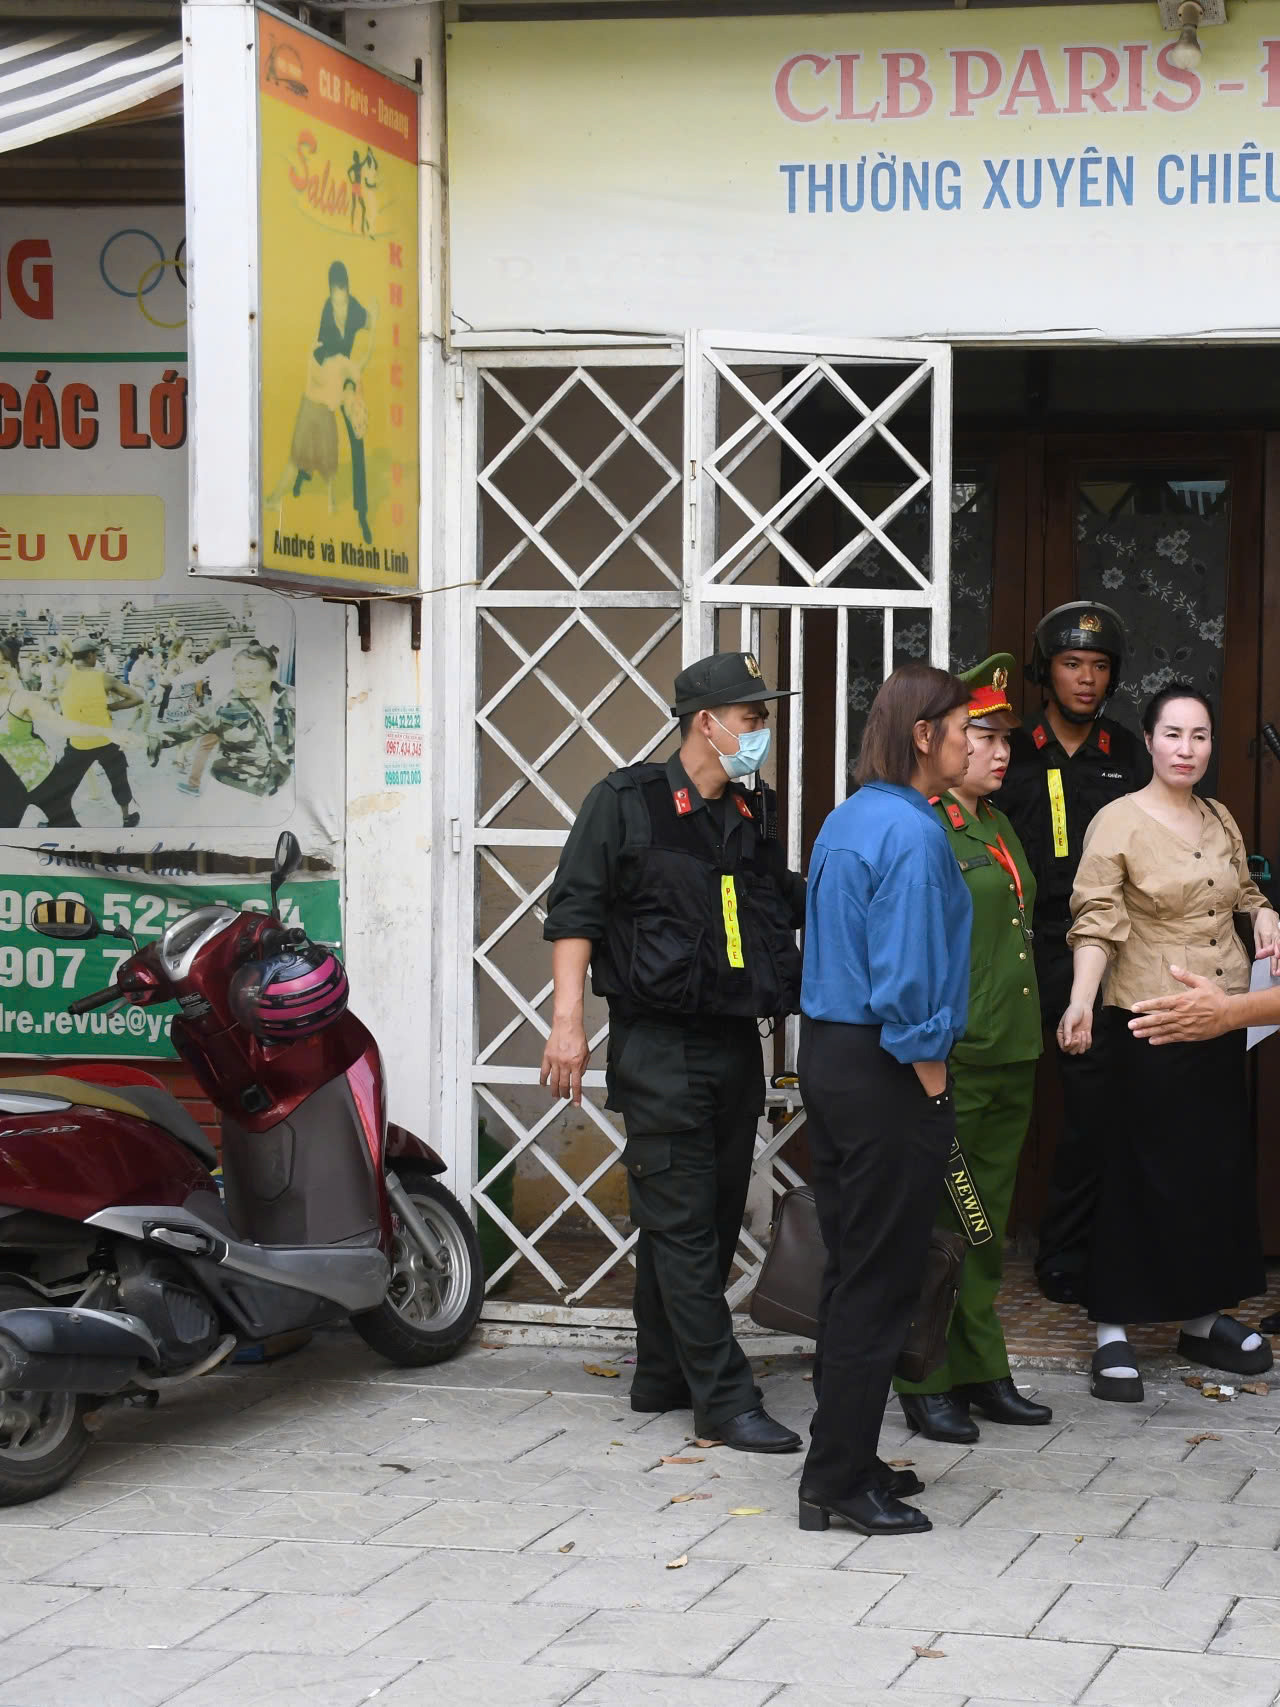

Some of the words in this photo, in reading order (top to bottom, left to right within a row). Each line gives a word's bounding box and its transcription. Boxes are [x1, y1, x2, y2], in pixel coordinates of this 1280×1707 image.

[319, 68, 342, 104] CLB
[344, 79, 369, 117] Paris
[378, 96, 409, 139] Danang
[775, 54, 932, 122] CLB
[950, 44, 1200, 116] PARIS
[289, 128, 349, 217] Salsa
[779, 152, 962, 214] THƯỜNG
[982, 147, 1136, 210] XUYÊN
[0, 240, 54, 320] G
[119, 370, 188, 450] LỚ
[68, 527, 129, 562] VŨ
[273, 529, 315, 560] André
[320, 538, 336, 563] và
[341, 541, 380, 570] Khánh
[384, 548, 409, 574] Linh
[1053, 781, 1064, 847] OLICE
[725, 887, 739, 960] POLICE
[0, 946, 86, 988] 907
[951, 1169, 988, 1233] NEWIN
